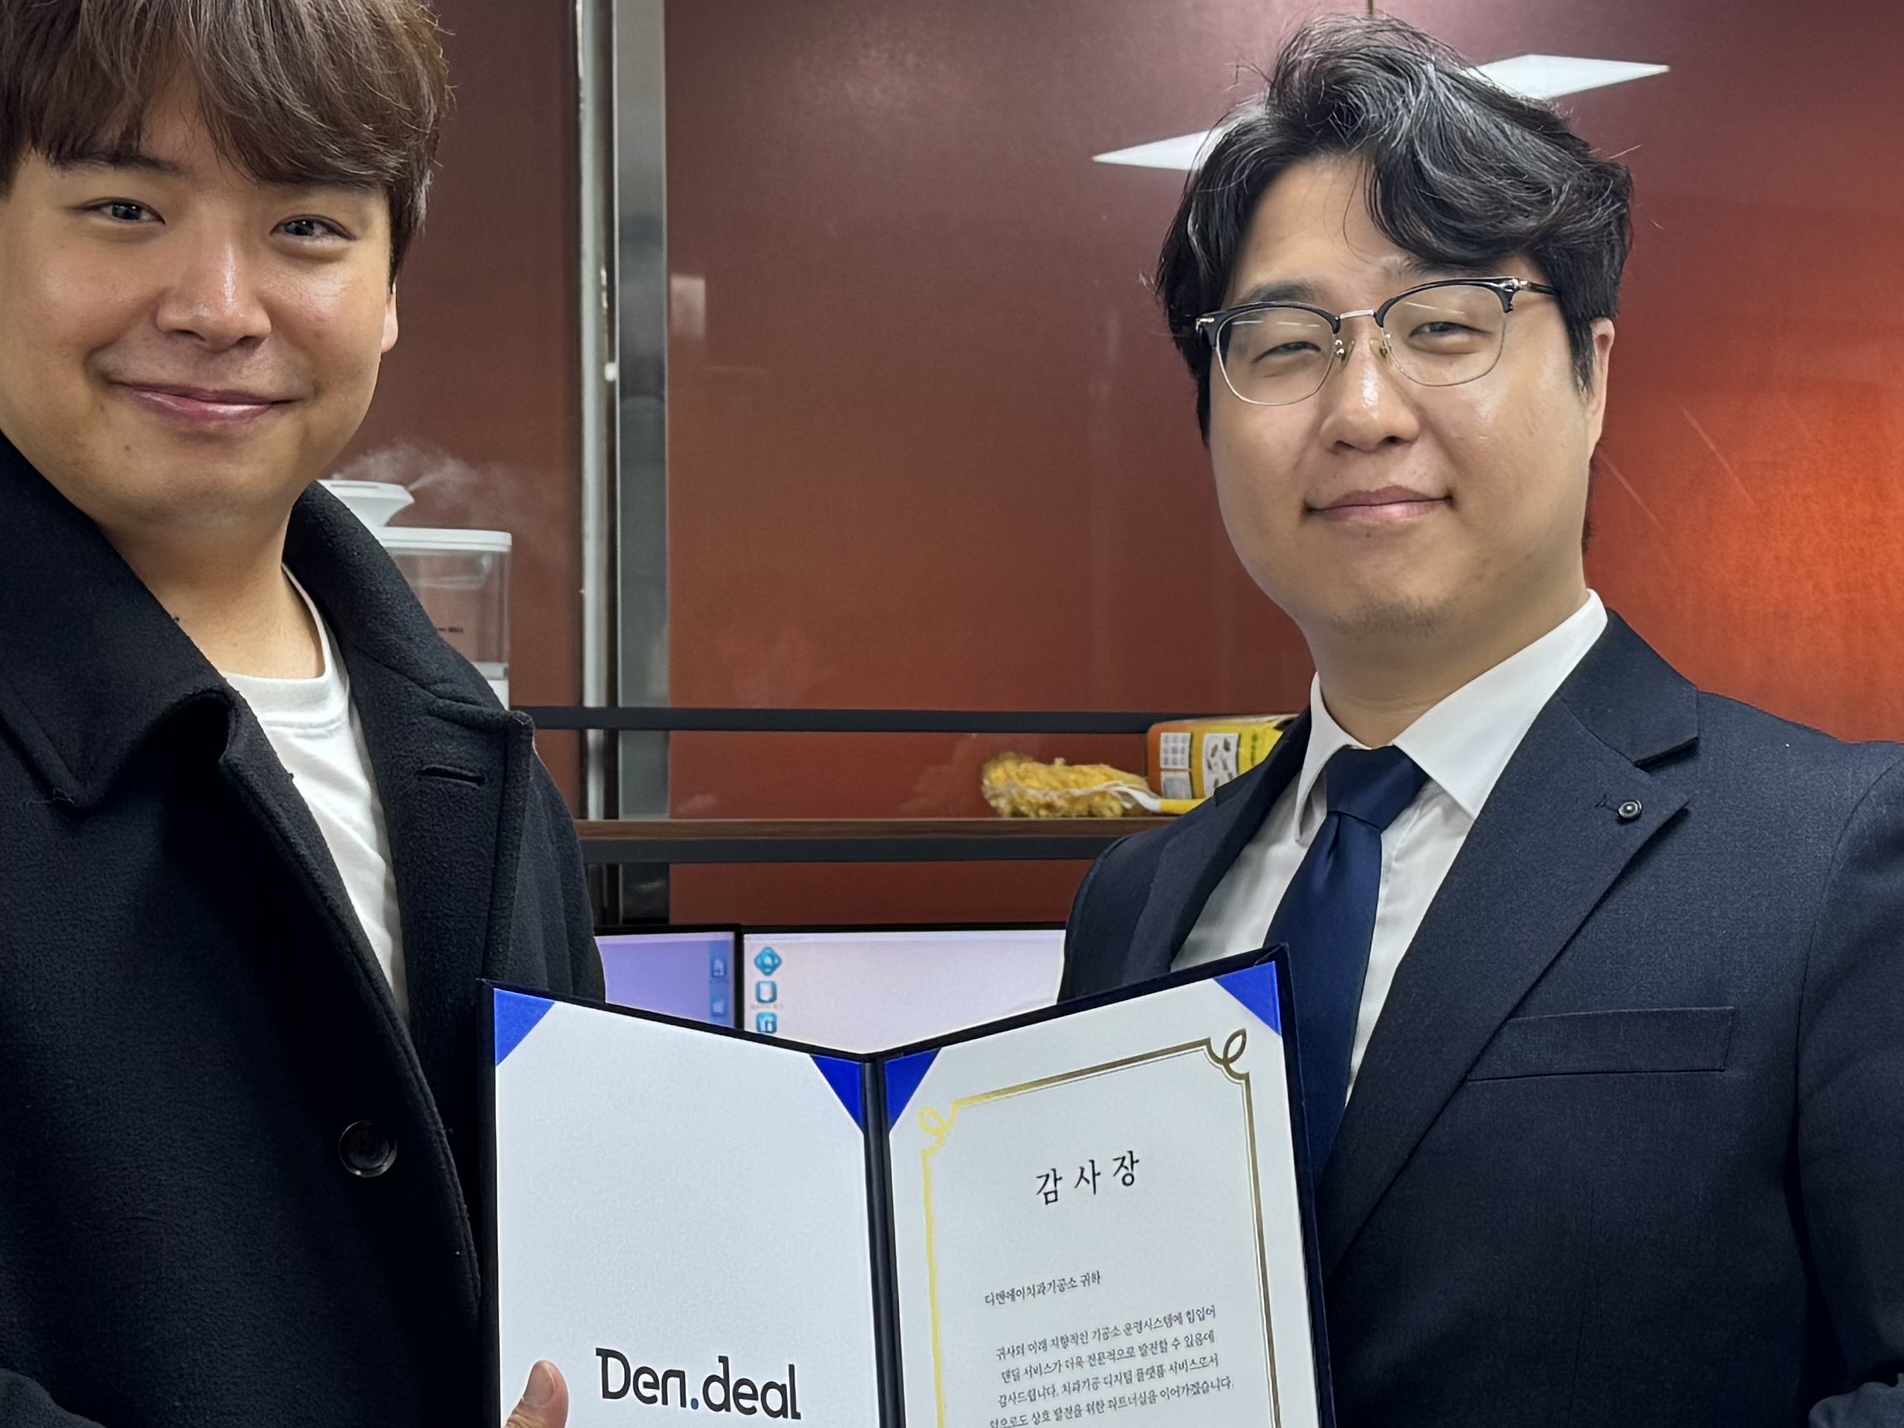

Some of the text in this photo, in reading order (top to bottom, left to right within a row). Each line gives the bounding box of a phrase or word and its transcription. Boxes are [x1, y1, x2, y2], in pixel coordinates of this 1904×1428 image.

[1080, 1270, 1101, 1287] 귀하
[1092, 1325, 1121, 1342] 기공소
[1123, 1311, 1183, 1336] 운영시스템에
[1185, 1304, 1216, 1324] 힘입어
[998, 1352, 1219, 1408] 감사드립니다. 치과기공 디지털 플랫폼 서비스로서
[1024, 1359, 1062, 1379] 서비스가
[1065, 1355, 1084, 1370] 더욱
[1087, 1346, 1136, 1368] 전문적으로
[1138, 1338, 1168, 1357] 발전할
[1171, 1337, 1181, 1350] 수
[595, 1347, 802, 1420] Den.deal
[1031, 1410, 1050, 1426] 상호
[1054, 1403, 1083, 1421] 발전을
[1086, 1399, 1105, 1415] 위한
[1160, 1375, 1234, 1400] 이어가겠습니다.
